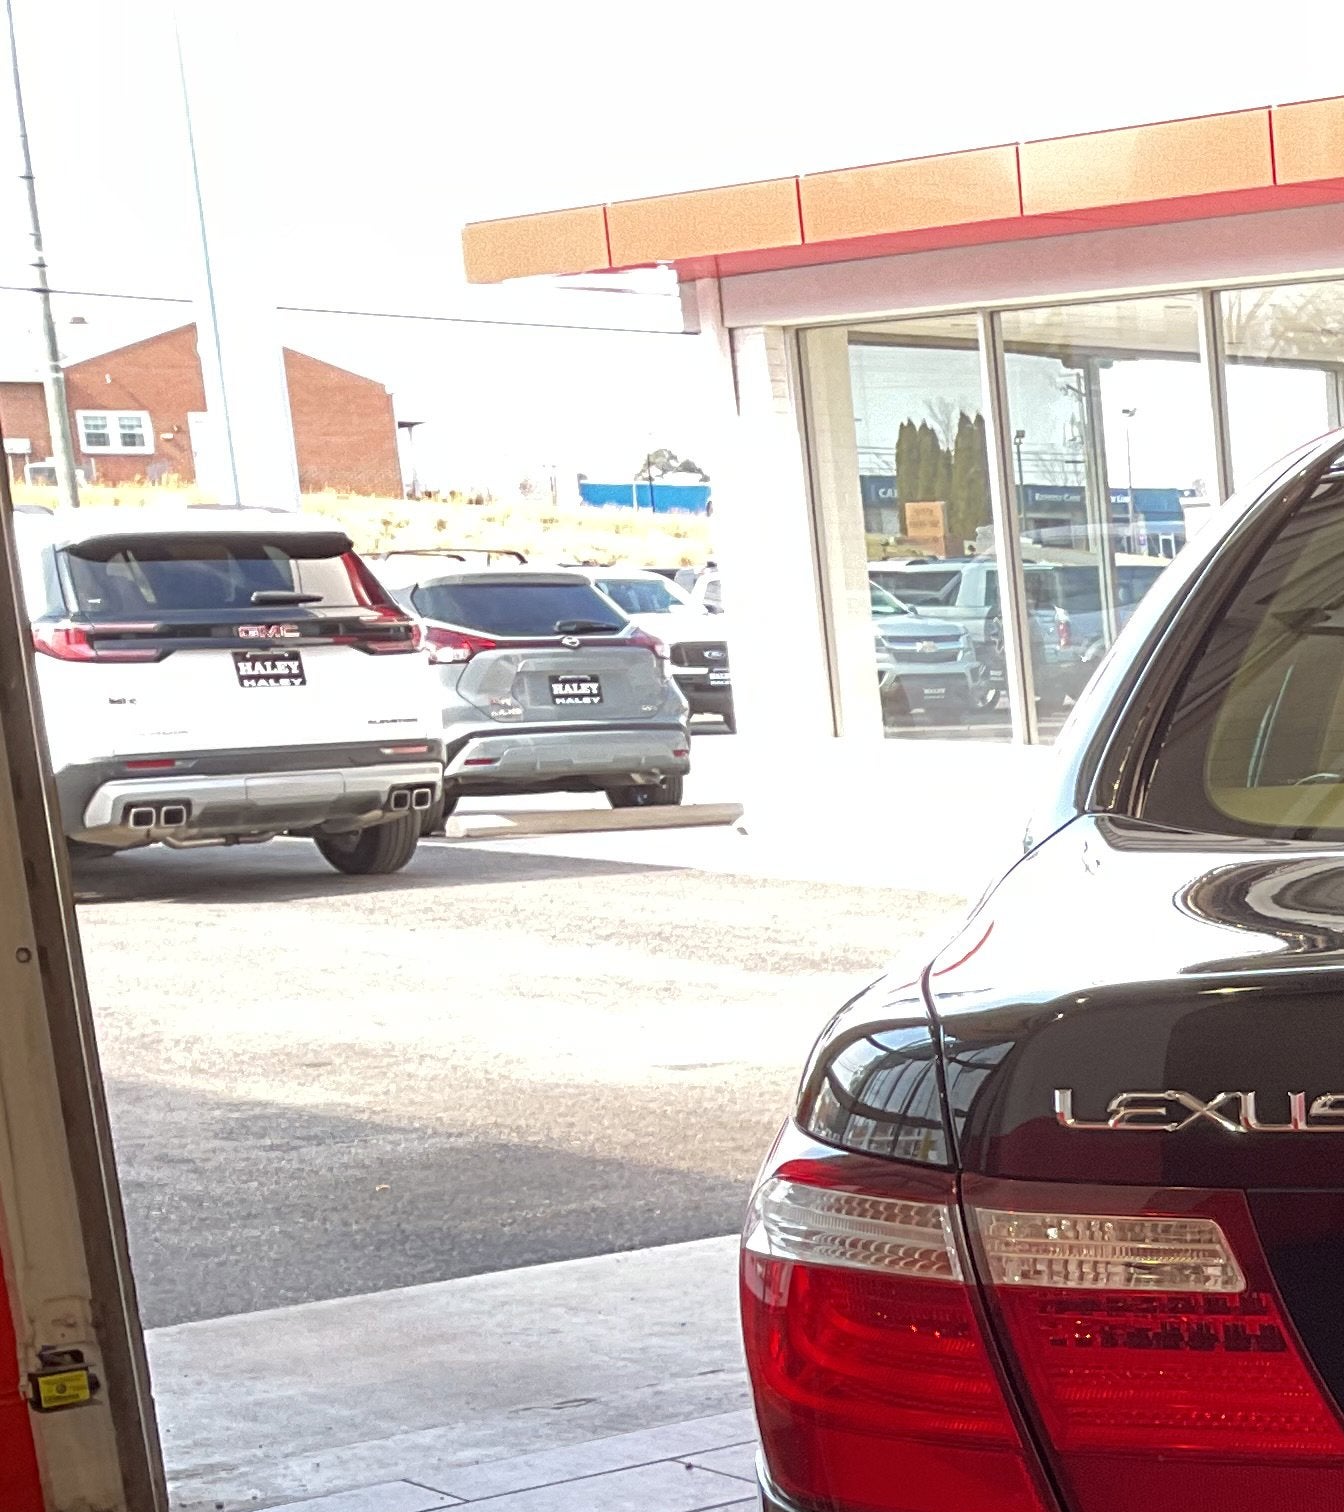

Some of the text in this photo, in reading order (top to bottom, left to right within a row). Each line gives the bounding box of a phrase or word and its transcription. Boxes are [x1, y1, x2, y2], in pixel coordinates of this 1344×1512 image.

[237, 623, 300, 639] GMC
[237, 660, 300, 676] HALEY
[243, 677, 303, 688] HALEY
[552, 682, 599, 695] HALEY
